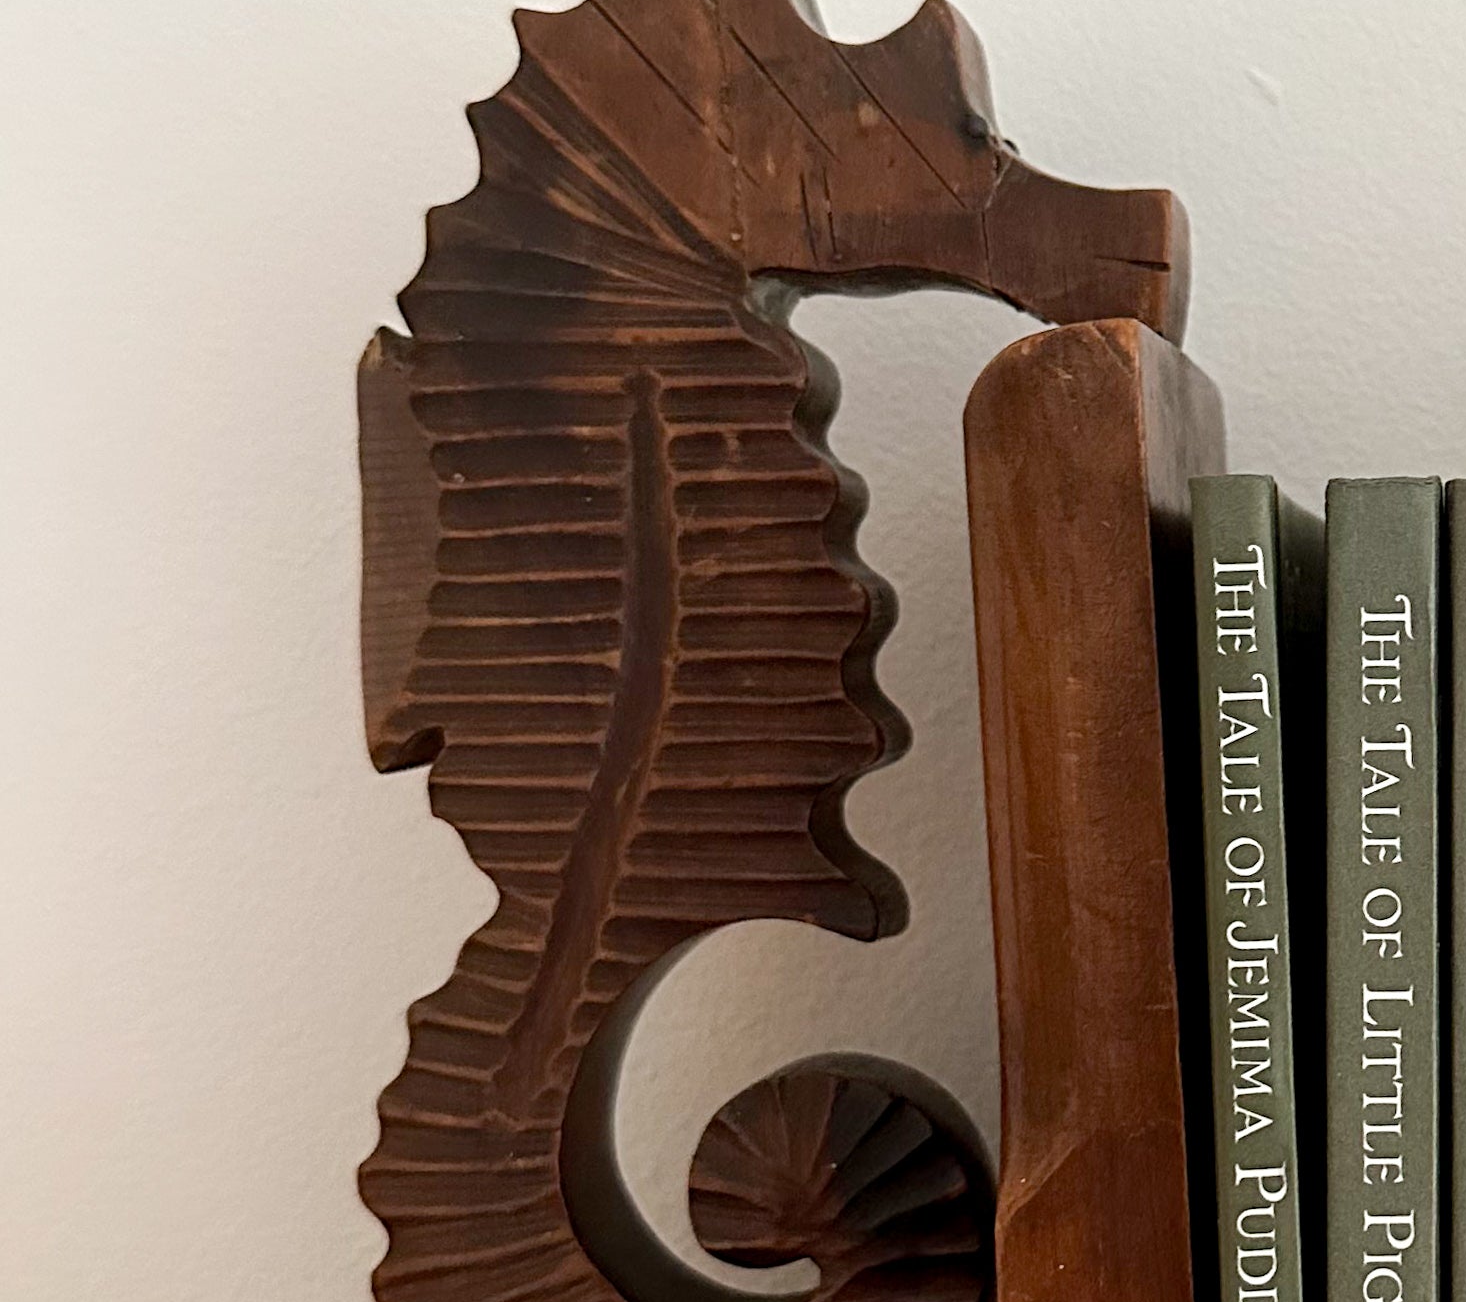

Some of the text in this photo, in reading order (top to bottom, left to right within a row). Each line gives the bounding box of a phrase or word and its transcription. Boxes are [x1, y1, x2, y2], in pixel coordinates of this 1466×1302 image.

[1213, 544, 1268, 655] THE
[1360, 594, 1414, 705] THE
[1218, 673, 1272, 815] TALE
[1360, 723, 1414, 865] TALE
[1225, 837, 1267, 907] OF
[1362, 888, 1403, 958] OF
[1226, 921, 1279, 1142] JEMIMA
[1362, 983, 1414, 1185] LITTLE
